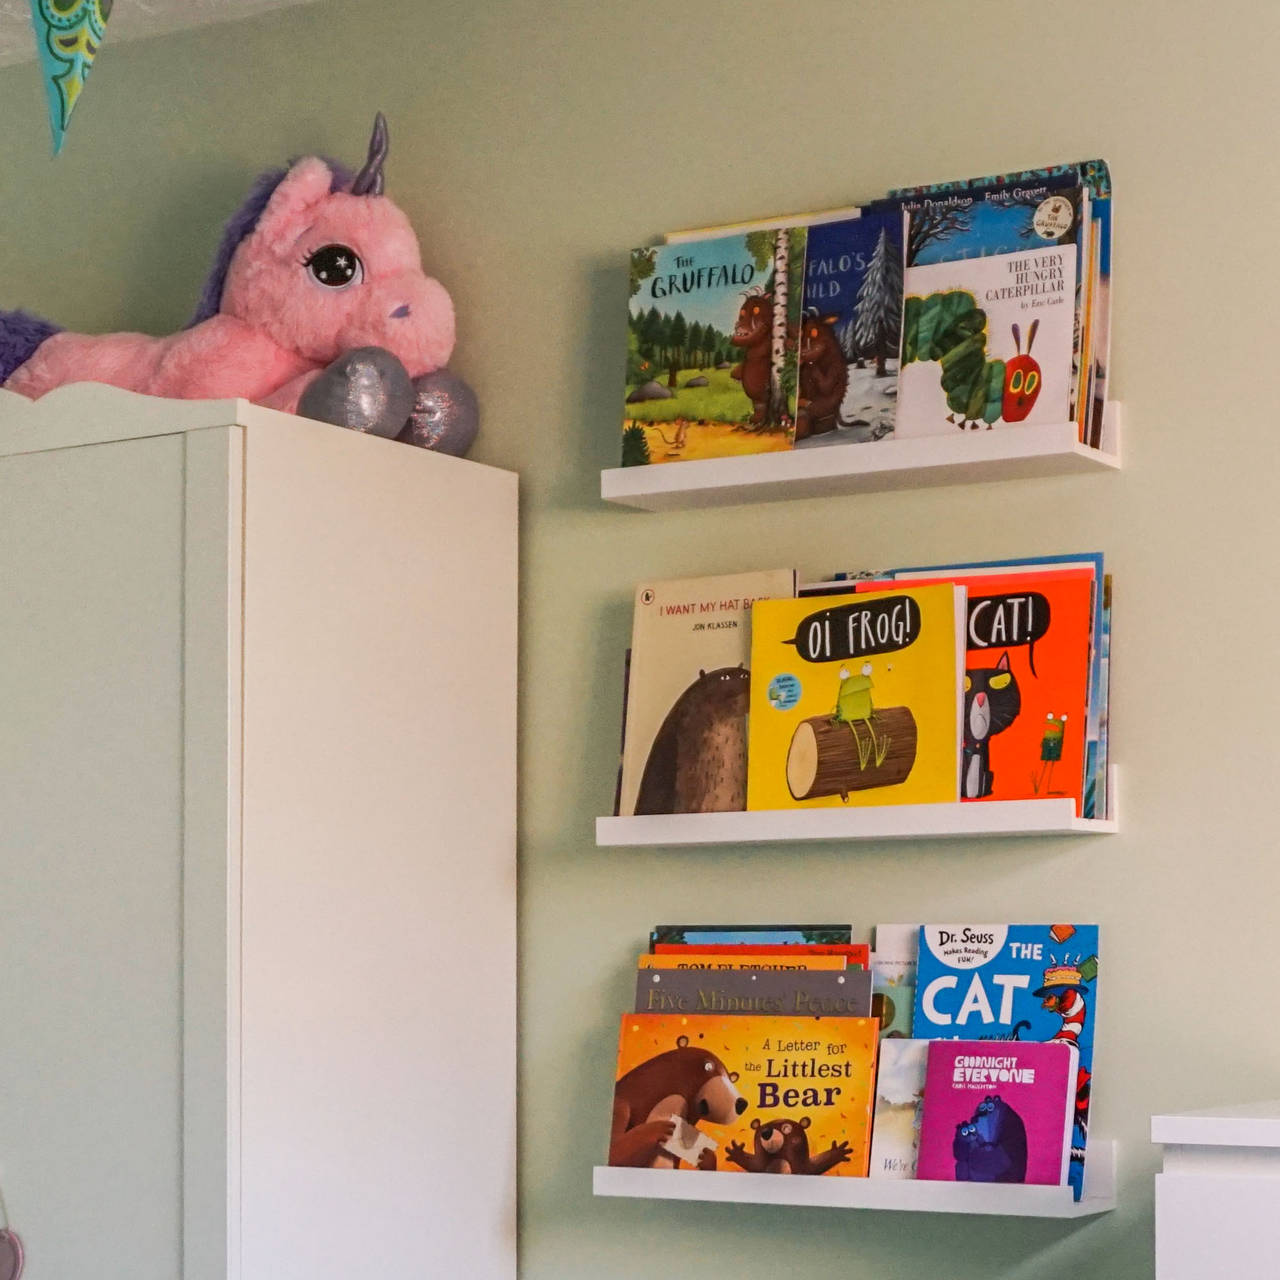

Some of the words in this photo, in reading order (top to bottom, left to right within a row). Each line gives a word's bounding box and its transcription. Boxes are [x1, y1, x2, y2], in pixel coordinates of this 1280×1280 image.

[924, 196, 973, 208] Donaldson
[985, 190, 1011, 201] Emily
[1012, 186, 1048, 199] Gravett
[1008, 258, 1030, 273] THE
[1034, 254, 1064, 270] VERY
[651, 263, 755, 298] GRUFFALO
[1016, 267, 1064, 285] HUNGRY
[985, 279, 1064, 301] CATERPILLAR
[665, 603, 696, 616] WANT
[700, 602, 717, 613] MY
[719, 599, 740, 611] HAT
[707, 621, 738, 630] KLASSEN
[848, 597, 911, 655] FROG!
[969, 596, 1033, 647] CAT!
[938, 931, 957, 946] Dr.
[961, 927, 994, 944] Seuss
[964, 947, 988, 958] Reading
[1009, 942, 1043, 960] THE
[647, 988, 688, 1011] Five
[794, 989, 857, 1013] Peace
[922, 972, 1031, 1026] CAT
[762, 1038, 771, 1050] A
[777, 1040, 821, 1052] Letter
[827, 1043, 847, 1056] for
[745, 1062, 761, 1072] the
[766, 1058, 852, 1078] Littlest
[954, 1055, 1018, 1069] GOODNIGHT
[953, 1067, 1036, 1084] EVERYONE
[757, 1082, 842, 1109] Bear
